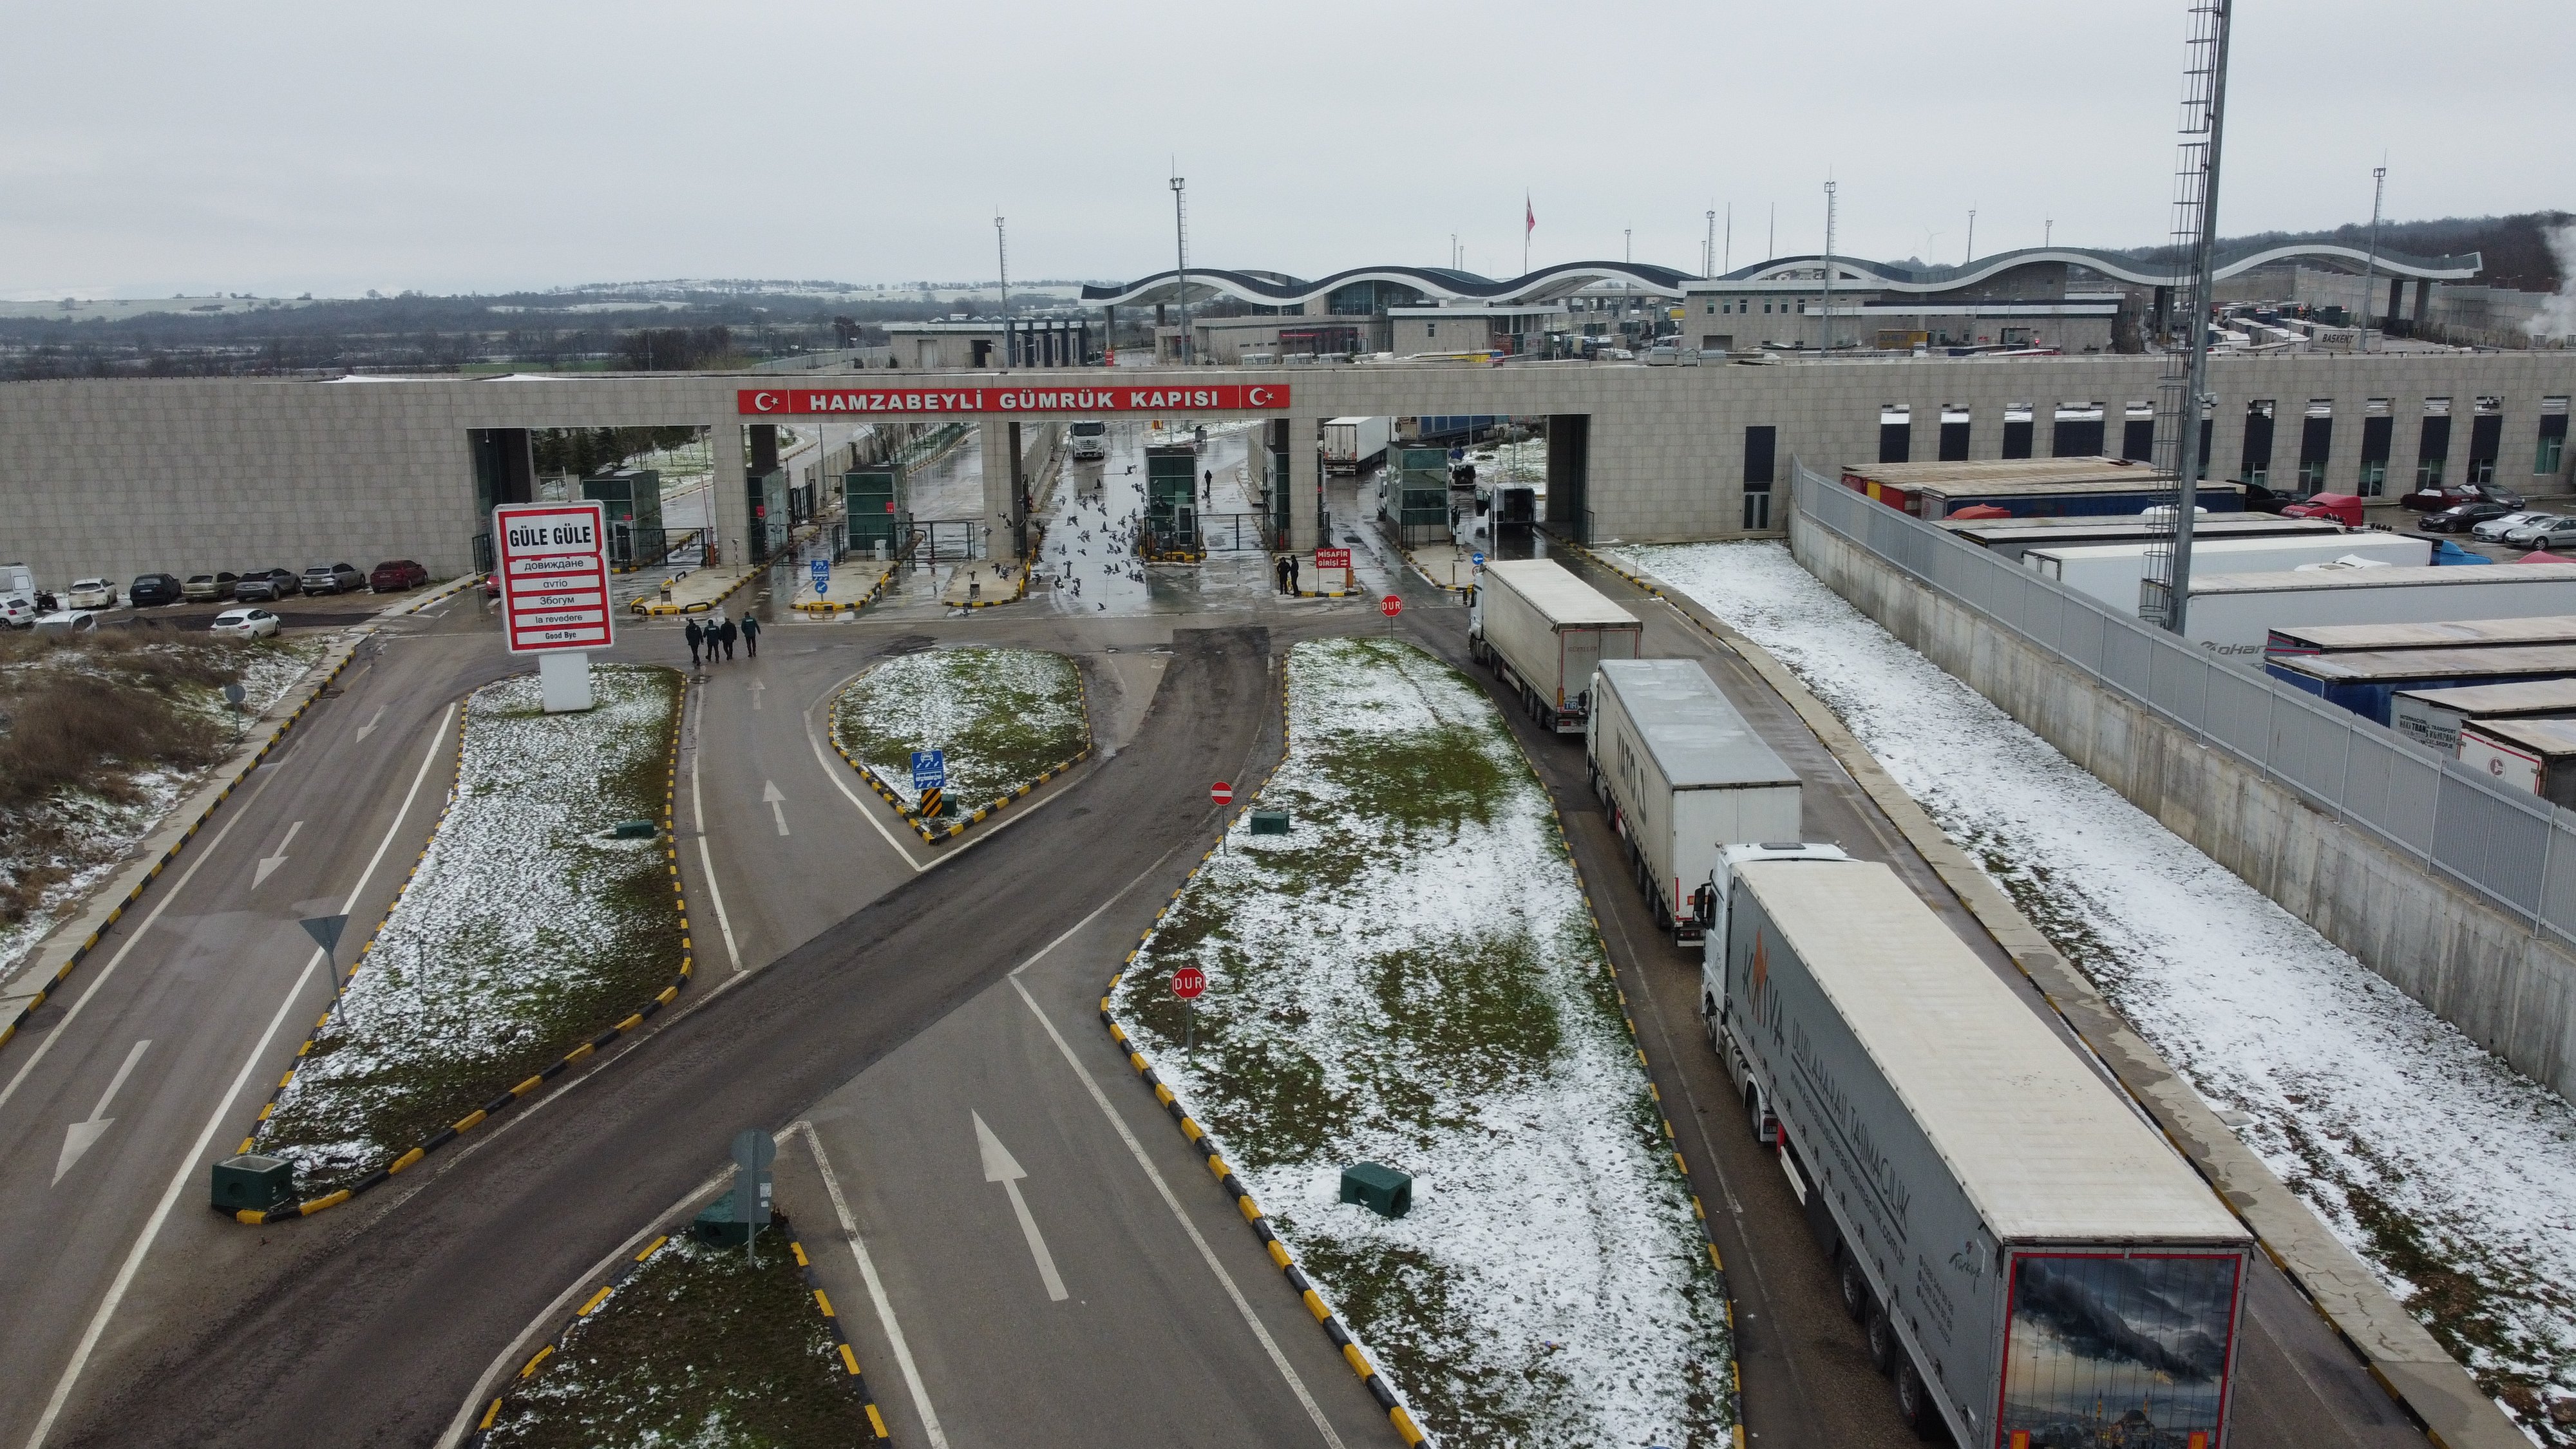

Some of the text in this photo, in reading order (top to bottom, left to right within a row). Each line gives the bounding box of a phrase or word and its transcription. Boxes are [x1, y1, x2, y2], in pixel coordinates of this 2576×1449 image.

[2322, 333, 2354, 345] BAŞKENT
[809, 388, 1219, 411] HAMZABEYLİ GÜMRÜK KAPISI
[509, 523, 592, 547] GÜLE GÜLE
[524, 559, 584, 571] довиждане
[543, 578, 568, 589] αντίο
[540, 596, 574, 606] Збогум
[1381, 601, 1401, 611] DUR
[545, 614, 583, 623] revedere
[545, 630, 577, 639] Good Bye
[1175, 976, 1202, 990] DUR
